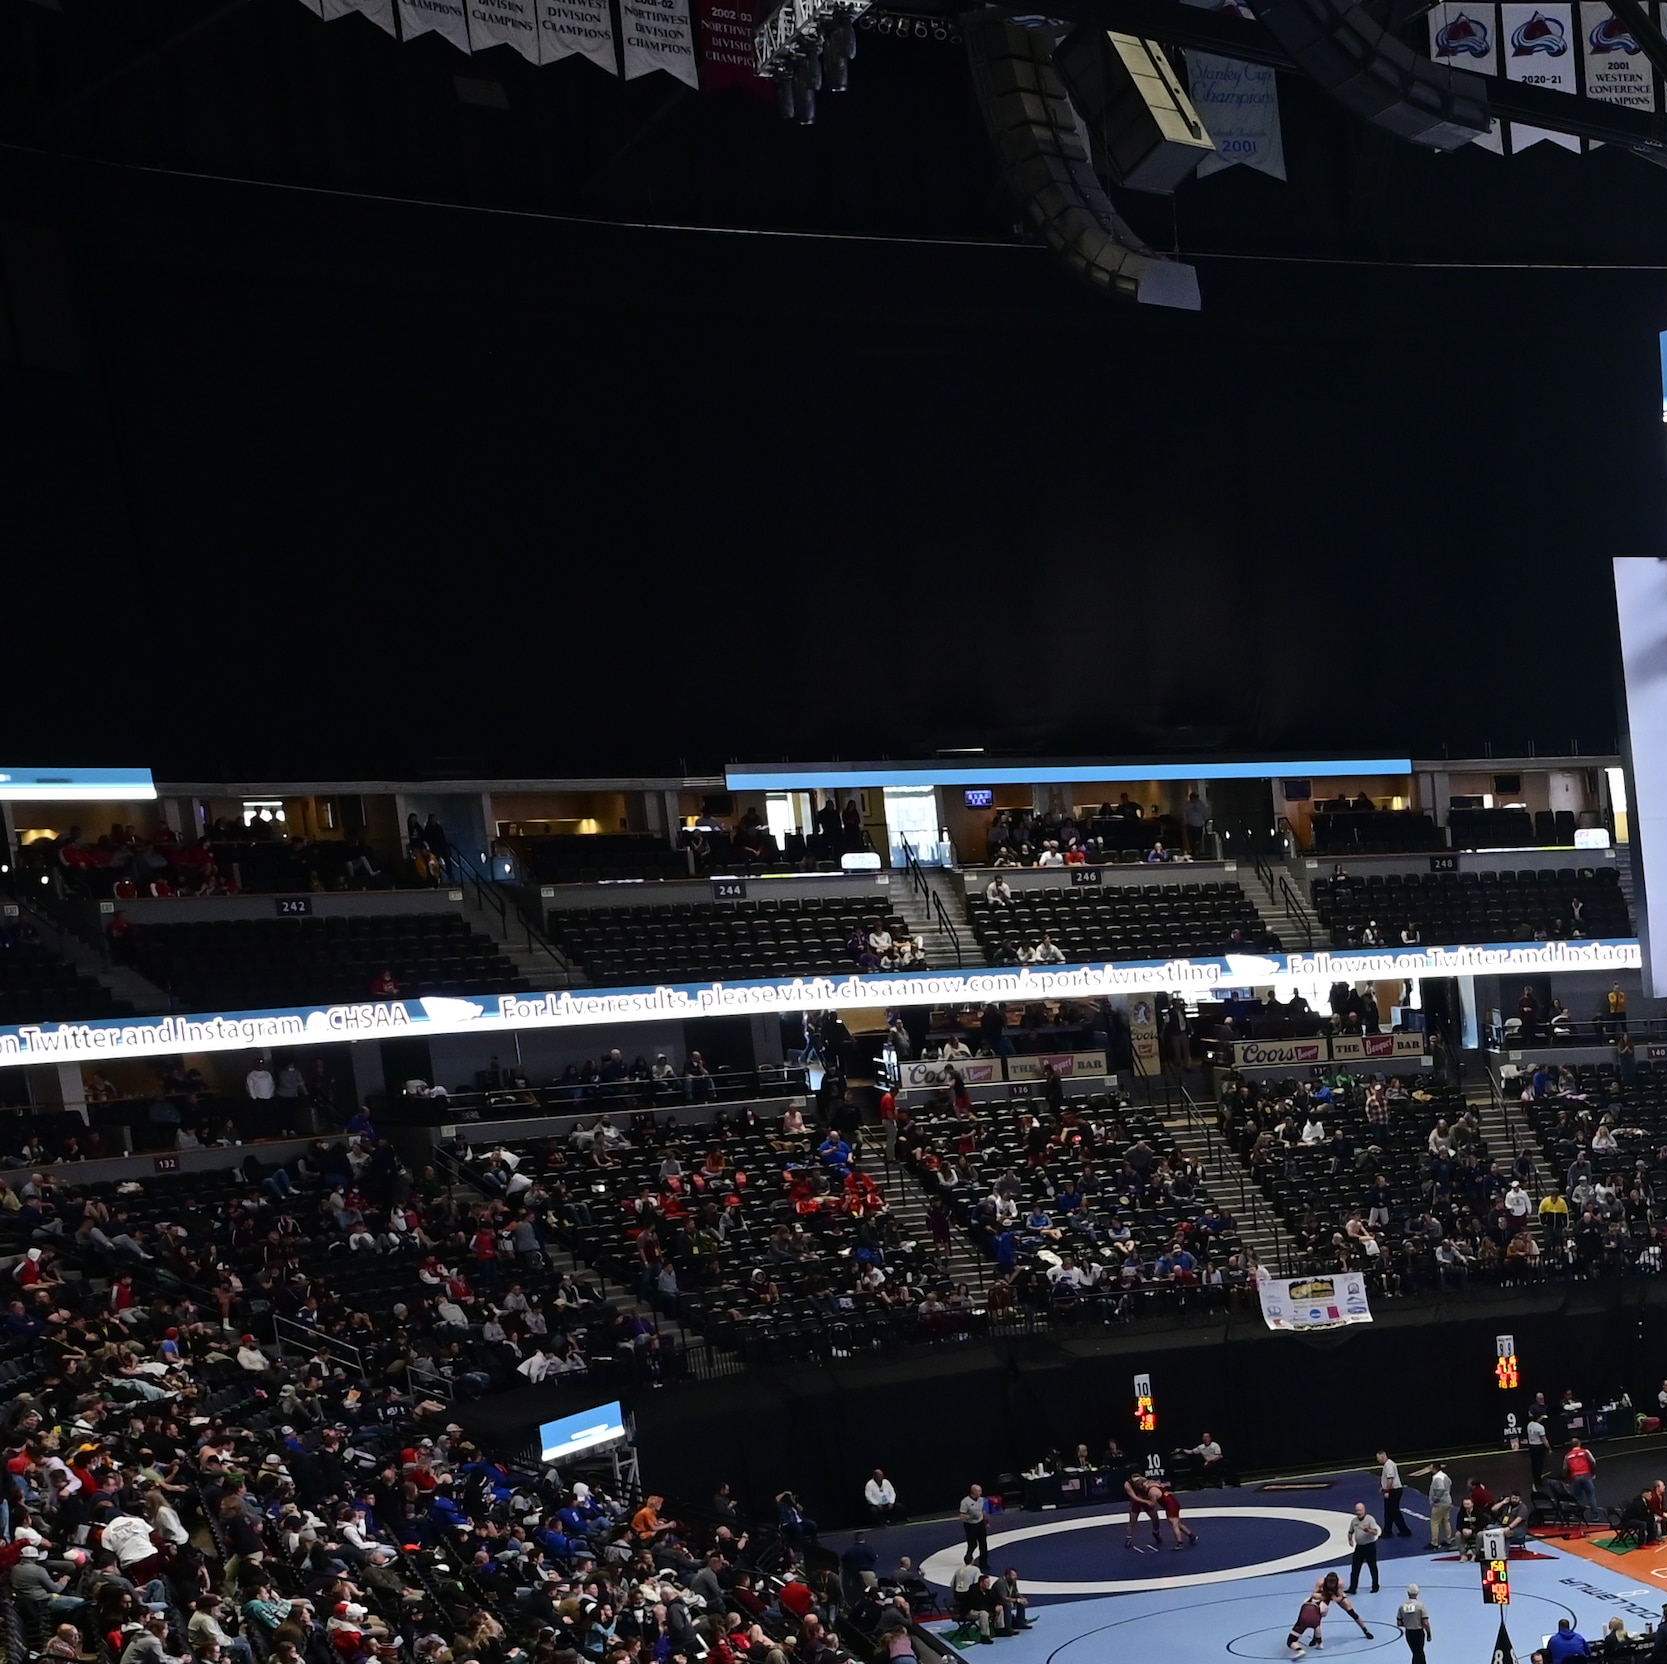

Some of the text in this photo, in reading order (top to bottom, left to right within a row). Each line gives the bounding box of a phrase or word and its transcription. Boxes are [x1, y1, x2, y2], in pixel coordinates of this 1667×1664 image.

[624, 6, 689, 25] NORTHWEST
[542, 20, 611, 40] CHAMPIONS
[635, 22, 684, 39] DIVISION
[627, 37, 692, 56] CHAMPIONS
[1607, 62, 1629, 71] 2001
[1595, 73, 1643, 83] WESTERN
[1192, 81, 1275, 108] Champions
[1589, 84, 1652, 95] CONFERENCE
[1222, 140, 1257, 152] 2001
[1076, 872, 1097, 882] 246
[719, 885, 741, 896] 244
[24, 949, 1508, 1052] Twitter and Instagram For Live please visit chsaanow.com/sports/wrestling Follow Twitter
[1242, 1042, 1296, 1064] Coors
[1336, 1041, 1421, 1054] THE BAR
[159, 1159, 176, 1169] 132
[1137, 1382, 1148, 1396] 10
[1504, 1426, 1522, 1436] MAT
[1147, 1454, 1160, 1469] 10
[1145, 1468, 1165, 1477] MAT
[1490, 1561, 1505, 1571] 158
[1493, 1594, 1508, 1604] 195
